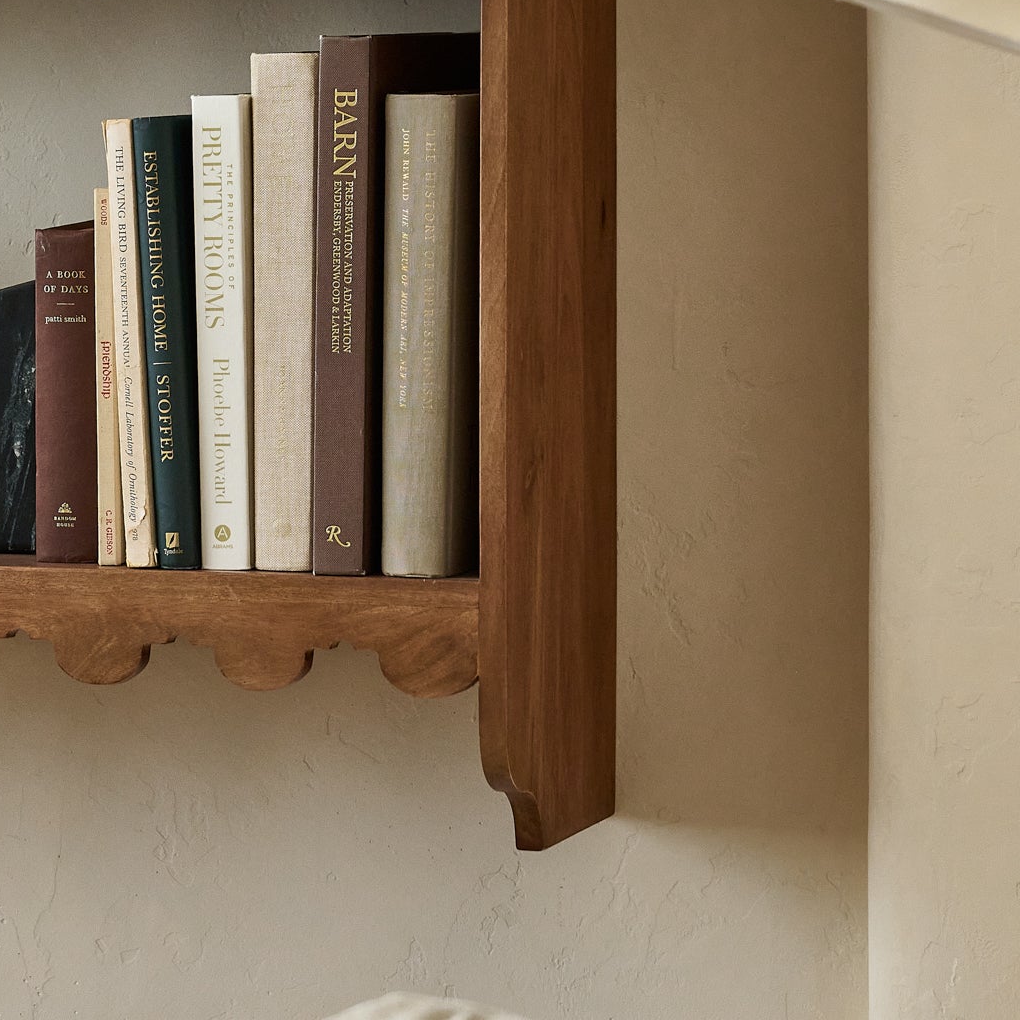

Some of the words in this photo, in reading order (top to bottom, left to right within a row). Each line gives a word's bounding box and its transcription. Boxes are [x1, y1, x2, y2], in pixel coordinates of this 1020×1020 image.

[333, 88, 358, 179] BARN
[401, 128, 410, 156] JOHN
[426, 129, 436, 164] THE
[115, 146, 125, 173] THE
[202, 125, 223, 227] PRETTY
[116, 176, 127, 220] LIVING
[401, 159, 410, 201] REWALD
[100, 198, 108, 226] WOODS
[143, 150, 165, 290] ESTABLISHING
[333, 181, 342, 236] ENDERSBY,
[344, 181, 354, 260] PRESERVATION
[401, 208, 409, 228] THE
[425, 172, 436, 243] HISTORY
[118, 223, 128, 253] BIRD
[226, 193, 235, 268] PRINCIPLES
[331, 237, 341, 305] GREENWOOD
[401, 232, 410, 272] MUSEUM
[43, 284, 57, 293] OF
[61, 285, 89, 294] DAYS
[45, 270, 53, 279] A
[57, 270, 87, 279] BOOK
[119, 256, 129, 327] SEVENTEENTH
[203, 235, 225, 330] ROOMS
[228, 275, 235, 290] OF
[343, 261, 353, 284] AND
[400, 274, 409, 288] OF
[45, 314, 62, 325] patti
[64, 314, 87, 323] smith
[151, 295, 168, 353] HOME
[331, 306, 340, 314] &
[342, 286, 353, 353] ADAPTATION
[400, 291, 408, 331] MODERN
[331, 315, 340, 354] LARKIN
[124, 376, 133, 408] Cornell
[212, 358, 231, 427] Phoebe
[399, 385, 407, 409] YORK
[125, 411, 135, 457] Laboratory
[156, 374, 174, 463] STOFFER
[126, 460, 137, 471] of
[214, 433, 233, 505] Howard
[128, 473, 139, 523] Ornithology
[105, 527, 114, 556] GIBSON
[325, 525, 351, 548] R
